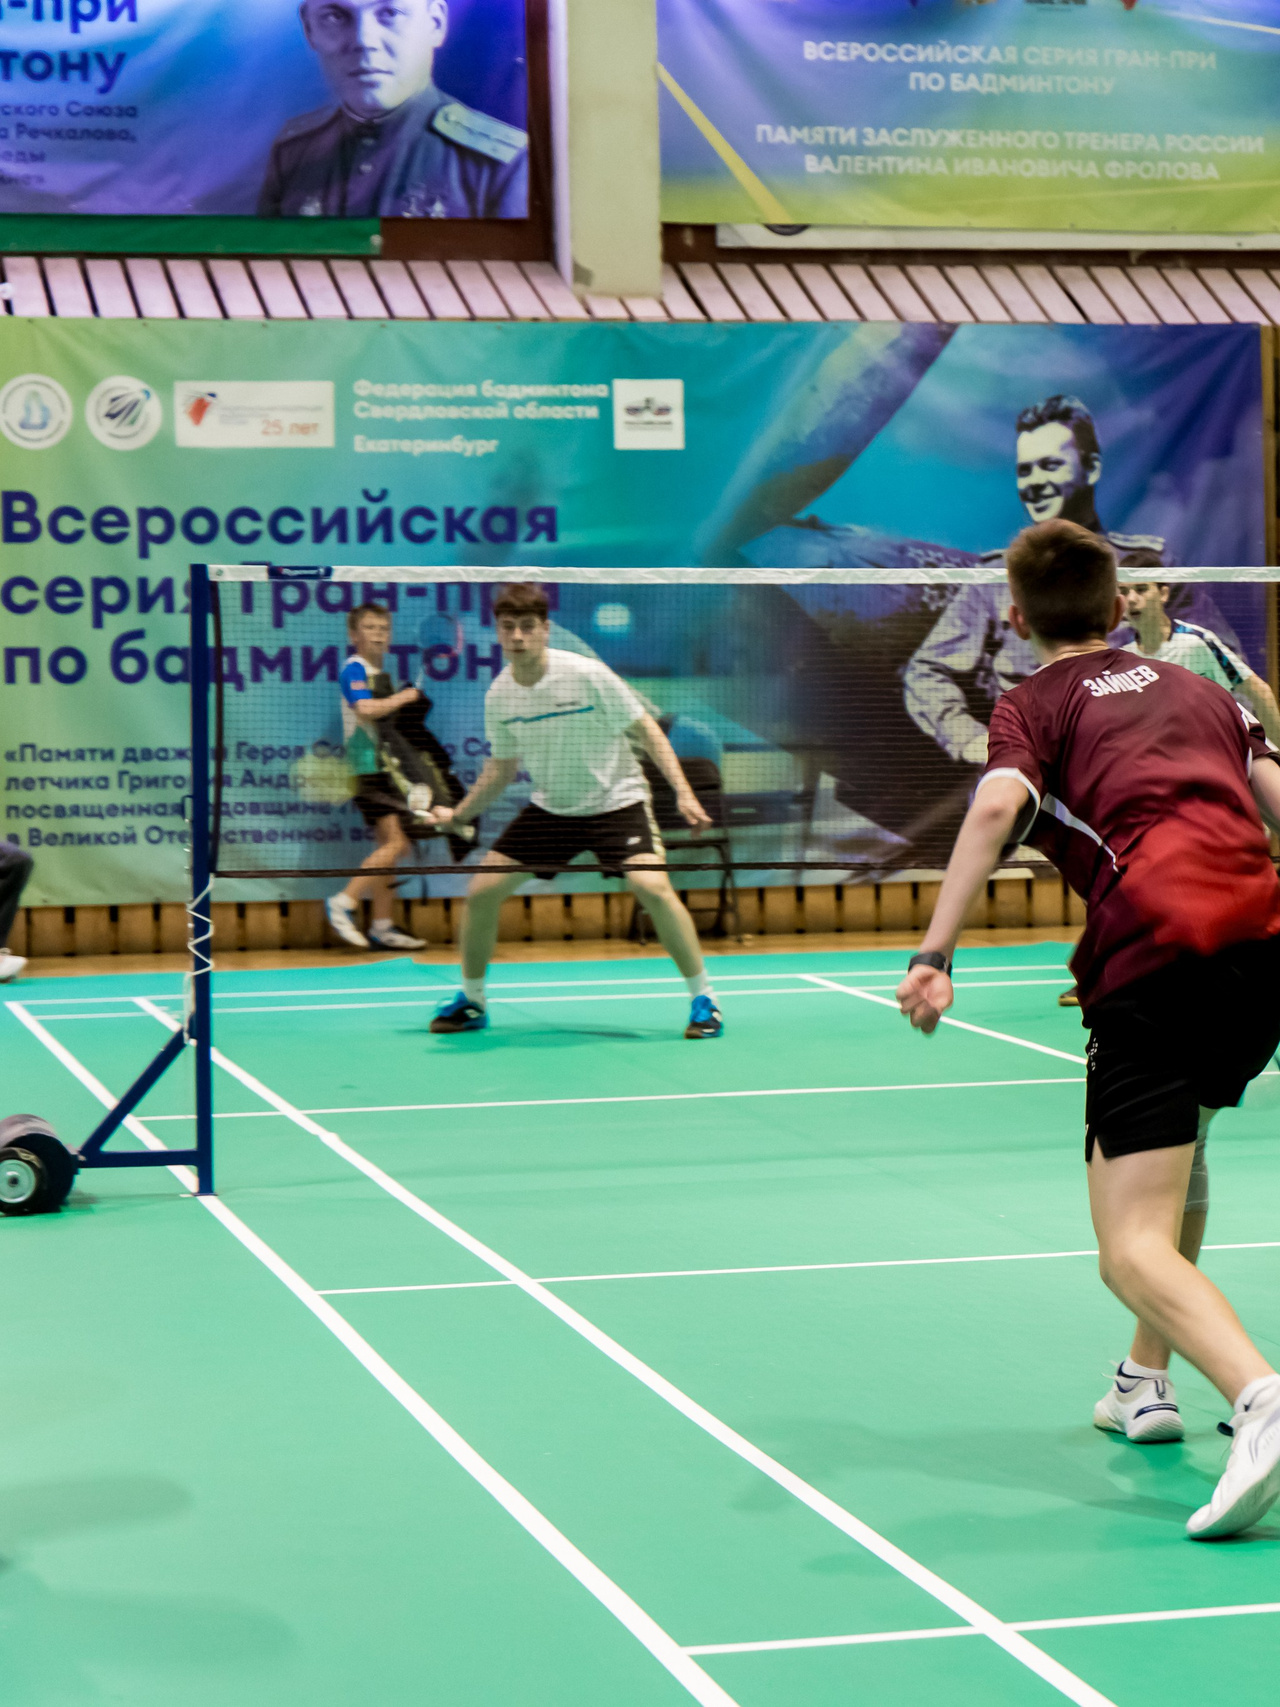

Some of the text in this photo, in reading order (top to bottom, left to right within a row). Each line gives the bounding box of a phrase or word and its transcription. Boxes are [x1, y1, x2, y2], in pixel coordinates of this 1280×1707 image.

[803, 40, 1217, 70] ВСЕРОССИЙСКАЯ СЕРИЯ ГРАН-ПРИ
[909, 72, 1115, 95] ПО БАДМИНТОНУ
[66, 101, 138, 118] Союза
[756, 124, 1265, 153] ПАМЯТИ ЗАСЛУЖЕННОГО ТРЕНЕРА РОССИИ
[804, 154, 1220, 180] ВАЛЕНТИНА ИВАНОВИЧА ФРОЛОВА
[353, 379, 608, 399] Федерация бадминтона
[353, 401, 599, 421] Свердловской области
[262, 420, 283, 434] 25
[354, 435, 499, 456] Екатеринбург
[1, 489, 558, 560] Всероссийская
[4, 646, 87, 684] по
[1082, 665, 1160, 697] ЗАЙЦЕВ
[4, 743, 115, 763] «Памяти
[5, 775, 110, 791] летчика
[28, 826, 137, 847] Великой
